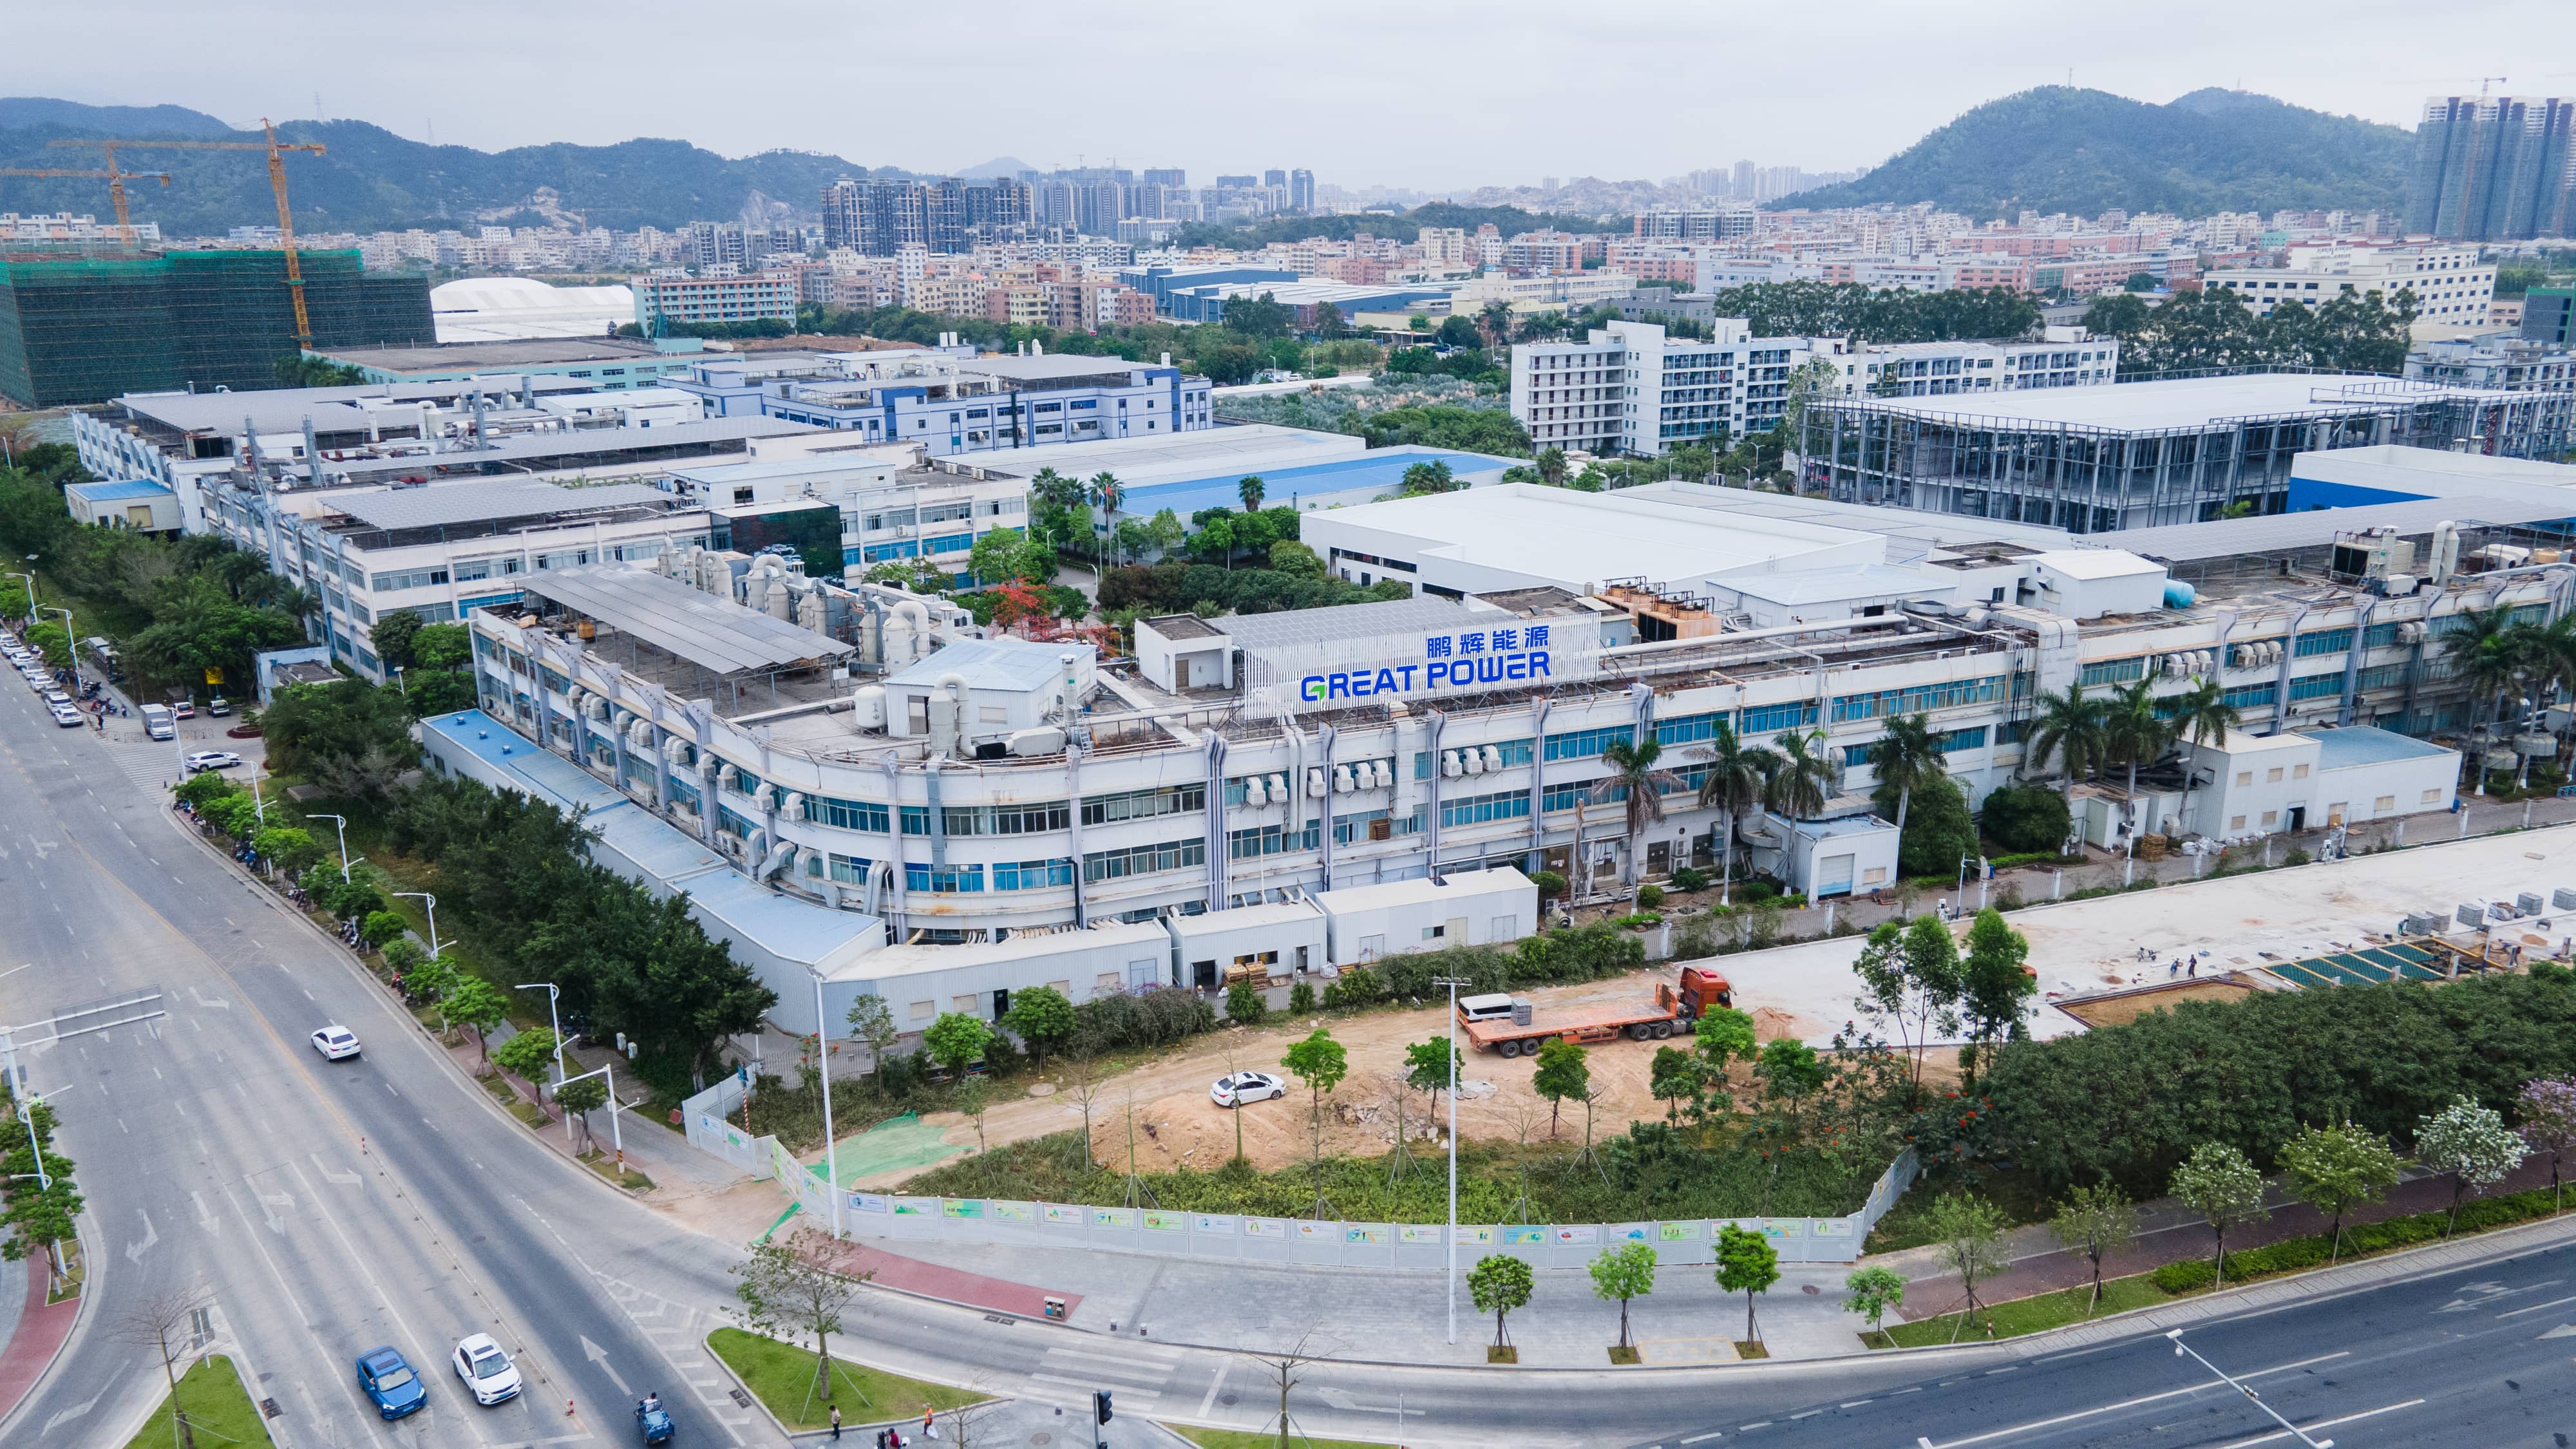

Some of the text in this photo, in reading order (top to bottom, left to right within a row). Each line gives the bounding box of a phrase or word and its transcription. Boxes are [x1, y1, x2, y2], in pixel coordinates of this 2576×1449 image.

[1427, 625, 1549, 659] 鹏辉能源
[1301, 650, 1551, 702] GREAT POWER
